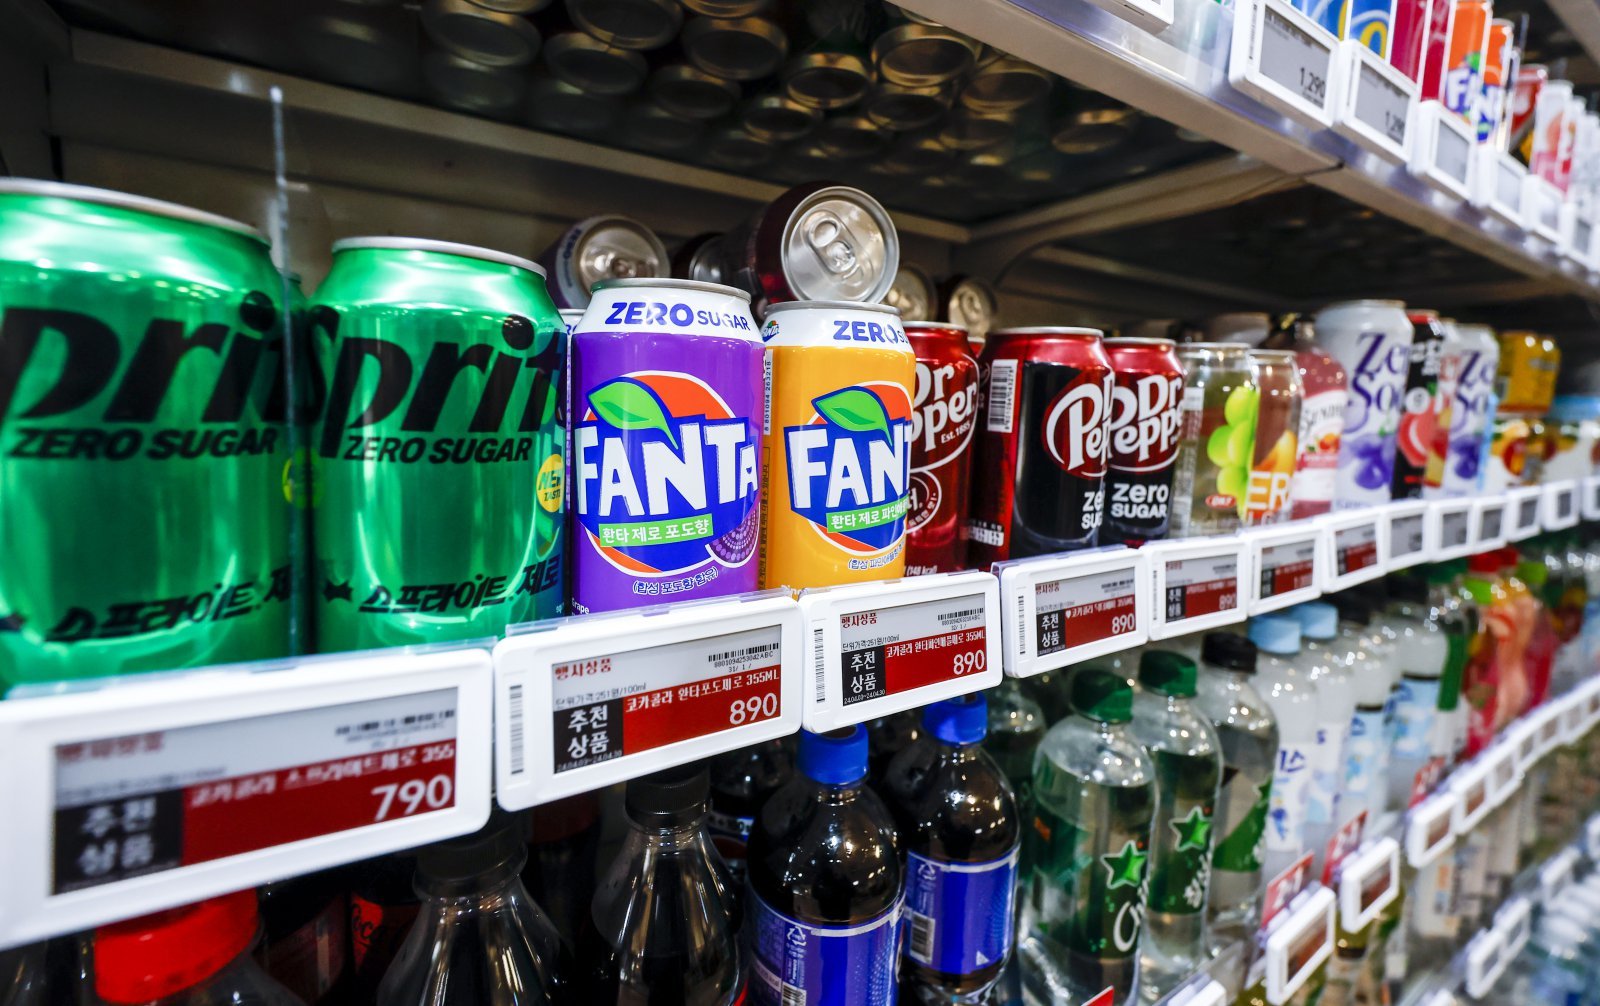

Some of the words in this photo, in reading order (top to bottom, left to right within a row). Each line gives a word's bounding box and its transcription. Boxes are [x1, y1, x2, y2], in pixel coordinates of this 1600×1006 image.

[604, 301, 695, 327] ZERO
[697, 309, 750, 332] SUGAR
[832, 320, 899, 344] ZERO
[1136, 374, 1183, 422] Dr
[9, 427, 149, 461] ZERO
[148, 427, 279, 460] SUGAR
[344, 436, 428, 463] ZERO
[428, 435, 533, 464] SUGAR
[941, 431, 956, 444] Est.
[574, 421, 760, 517] FANTA
[1111, 482, 1169, 504] zero
[830, 512, 857, 530] 환타
[858, 510, 882, 526] 제로
[1110, 502, 1168, 519] SUGAR
[601, 527, 630, 545] 환타
[632, 526, 663, 542] 제로
[664, 518, 711, 540] 포도향
[359, 572, 519, 615] 스프라이트
[518, 555, 562, 599] 제로
[632, 579, 660, 595] (합성
[660, 577, 694, 595] 포도향
[694, 566, 719, 586] 함유)
[44, 580, 262, 643] 스프라이트
[841, 612, 878, 629] 행사상품
[1041, 612, 1059, 631] 추천
[1111, 613, 1135, 635] 890
[886, 643, 913, 658] 코카콜라
[965, 630, 985, 642] 355ML
[1041, 631, 1060, 649] 상품
[554, 657, 612, 681] 행사상품
[850, 650, 876, 673] 추천
[953, 649, 985, 675] 890
[625, 692, 673, 713] 코카콜라
[746, 669, 781, 686] 355ML
[850, 673, 877, 694] 상품
[567, 703, 608, 733] 추천
[729, 692, 778, 726] 890
[567, 734, 609, 760] 상품
[370, 772, 454, 823] 790
